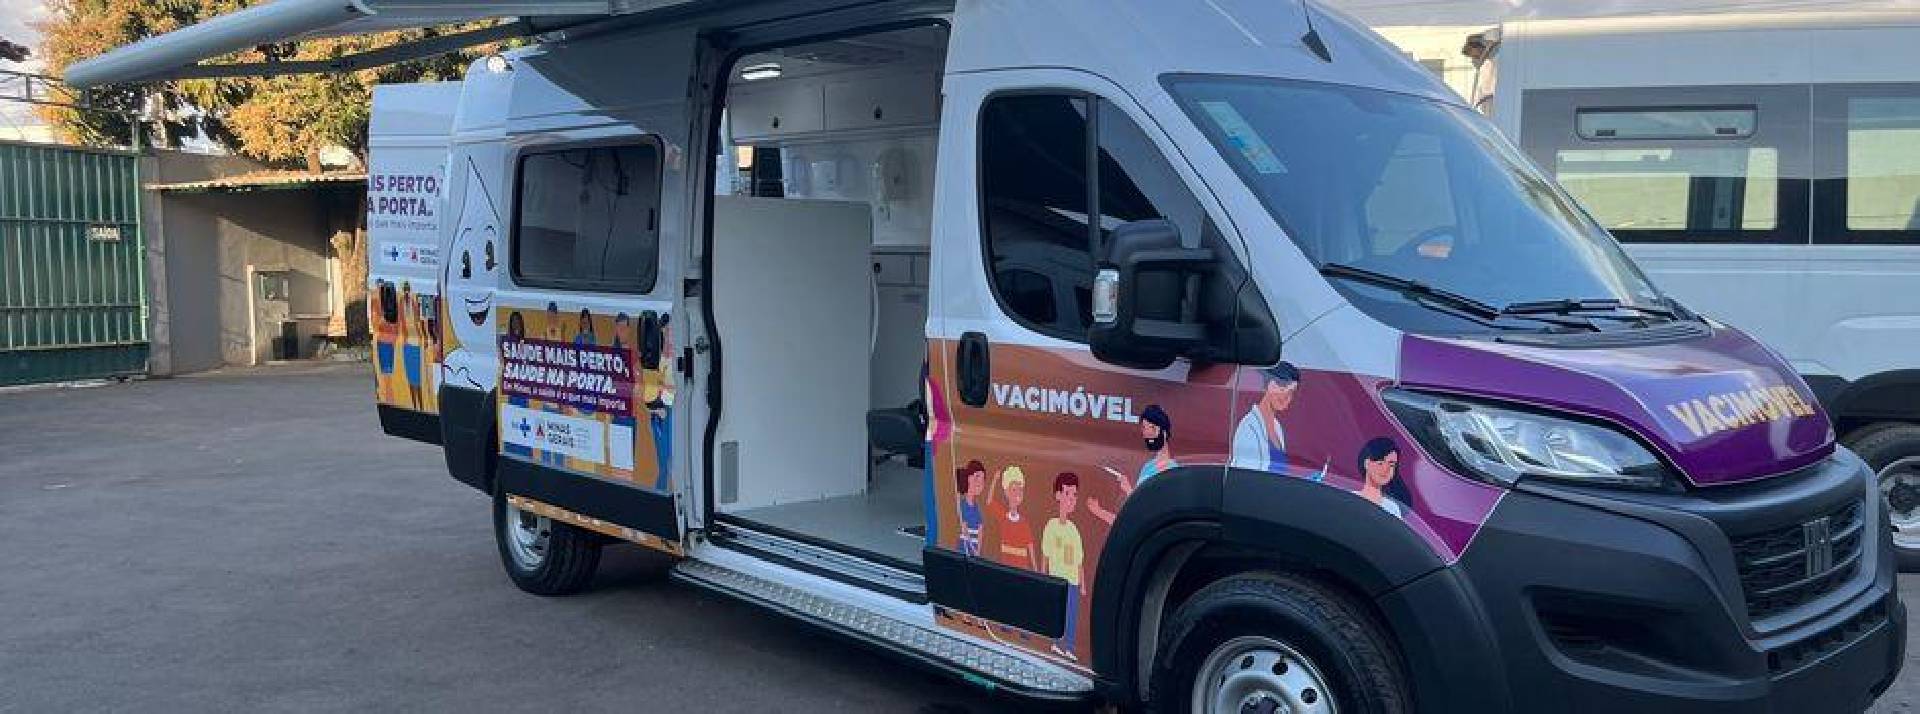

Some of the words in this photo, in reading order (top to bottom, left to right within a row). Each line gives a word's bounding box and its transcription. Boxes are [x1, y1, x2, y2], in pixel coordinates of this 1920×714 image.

[367, 175, 384, 191] IS
[389, 175, 440, 197] PERTO,
[379, 197, 434, 216] PORTA.
[503, 339, 544, 362] SAÚDE
[545, 346, 577, 367] MAIS
[579, 350, 630, 378] PERTO,
[503, 361, 546, 384] SAÚDE
[546, 367, 564, 387] NA
[566, 370, 617, 394] PORTA.
[993, 382, 1140, 424] VACIMÓVEL
[1665, 384, 1815, 438] VACIMÓVEL
